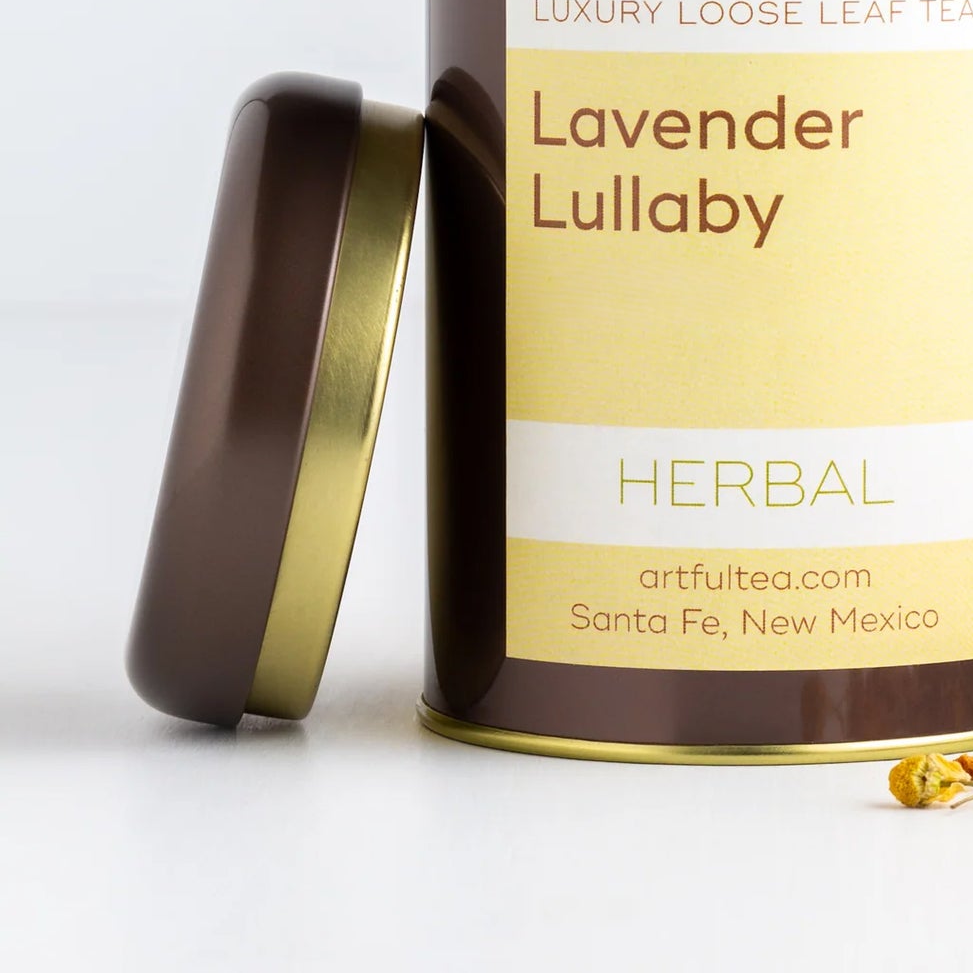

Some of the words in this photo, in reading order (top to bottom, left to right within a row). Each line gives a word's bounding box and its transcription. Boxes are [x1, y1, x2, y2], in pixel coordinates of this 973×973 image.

[678, 0, 803, 25] LOOSE
[820, 0, 907, 24] LEAF
[533, 90, 864, 150] Lavender
[533, 173, 784, 249] Lullaby
[619, 458, 895, 507] HERBAL
[639, 563, 872, 590] artfultea.com
[570, 603, 667, 634] Santa
[682, 608, 728, 640] Fe,
[741, 608, 817, 635] New
[830, 604, 940, 634] Mexico
